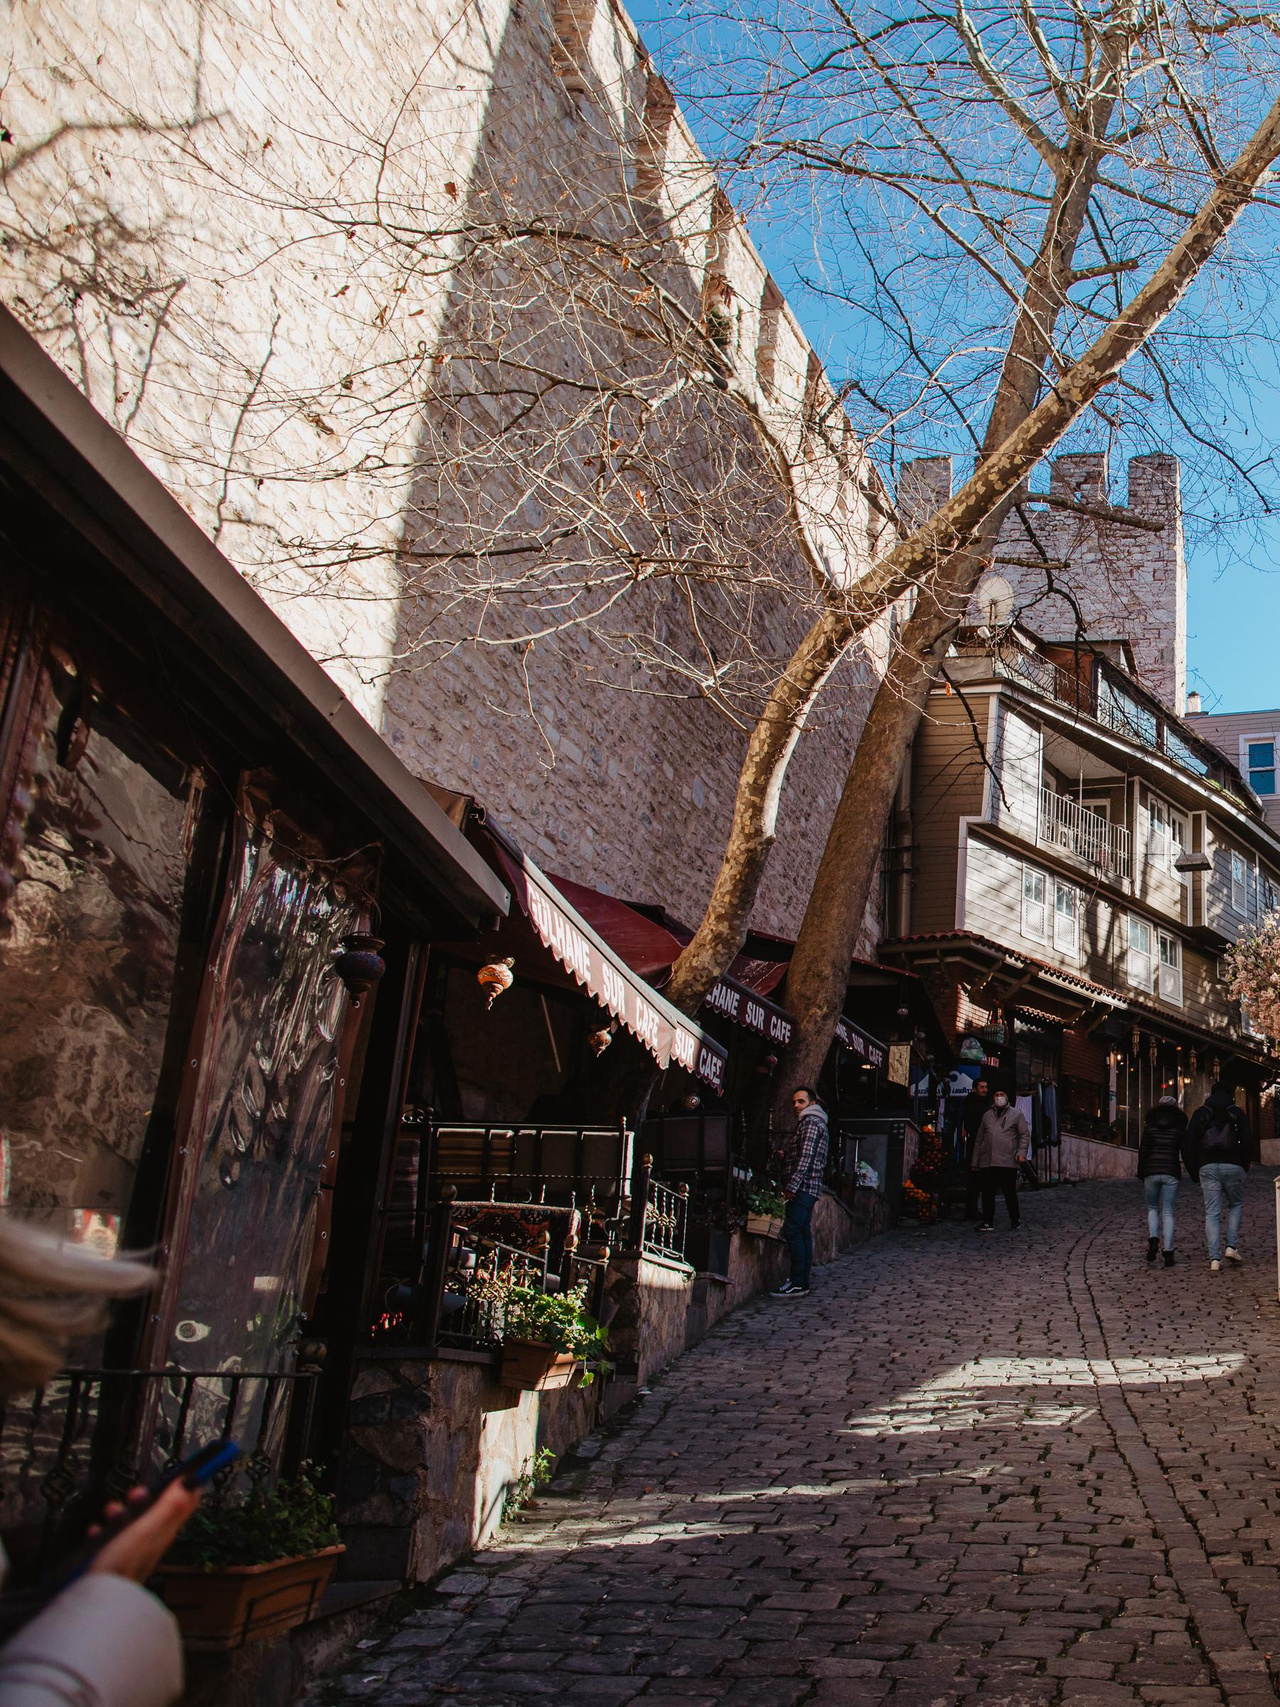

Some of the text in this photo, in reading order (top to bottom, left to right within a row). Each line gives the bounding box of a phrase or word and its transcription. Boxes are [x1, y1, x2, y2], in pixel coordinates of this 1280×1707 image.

[528, 882, 660, 1048] GÜLHANE SUR CAFE
[706, 983, 792, 1044] HANE SUR CAFE
[675, 1028, 723, 1085] SUR CAFE
